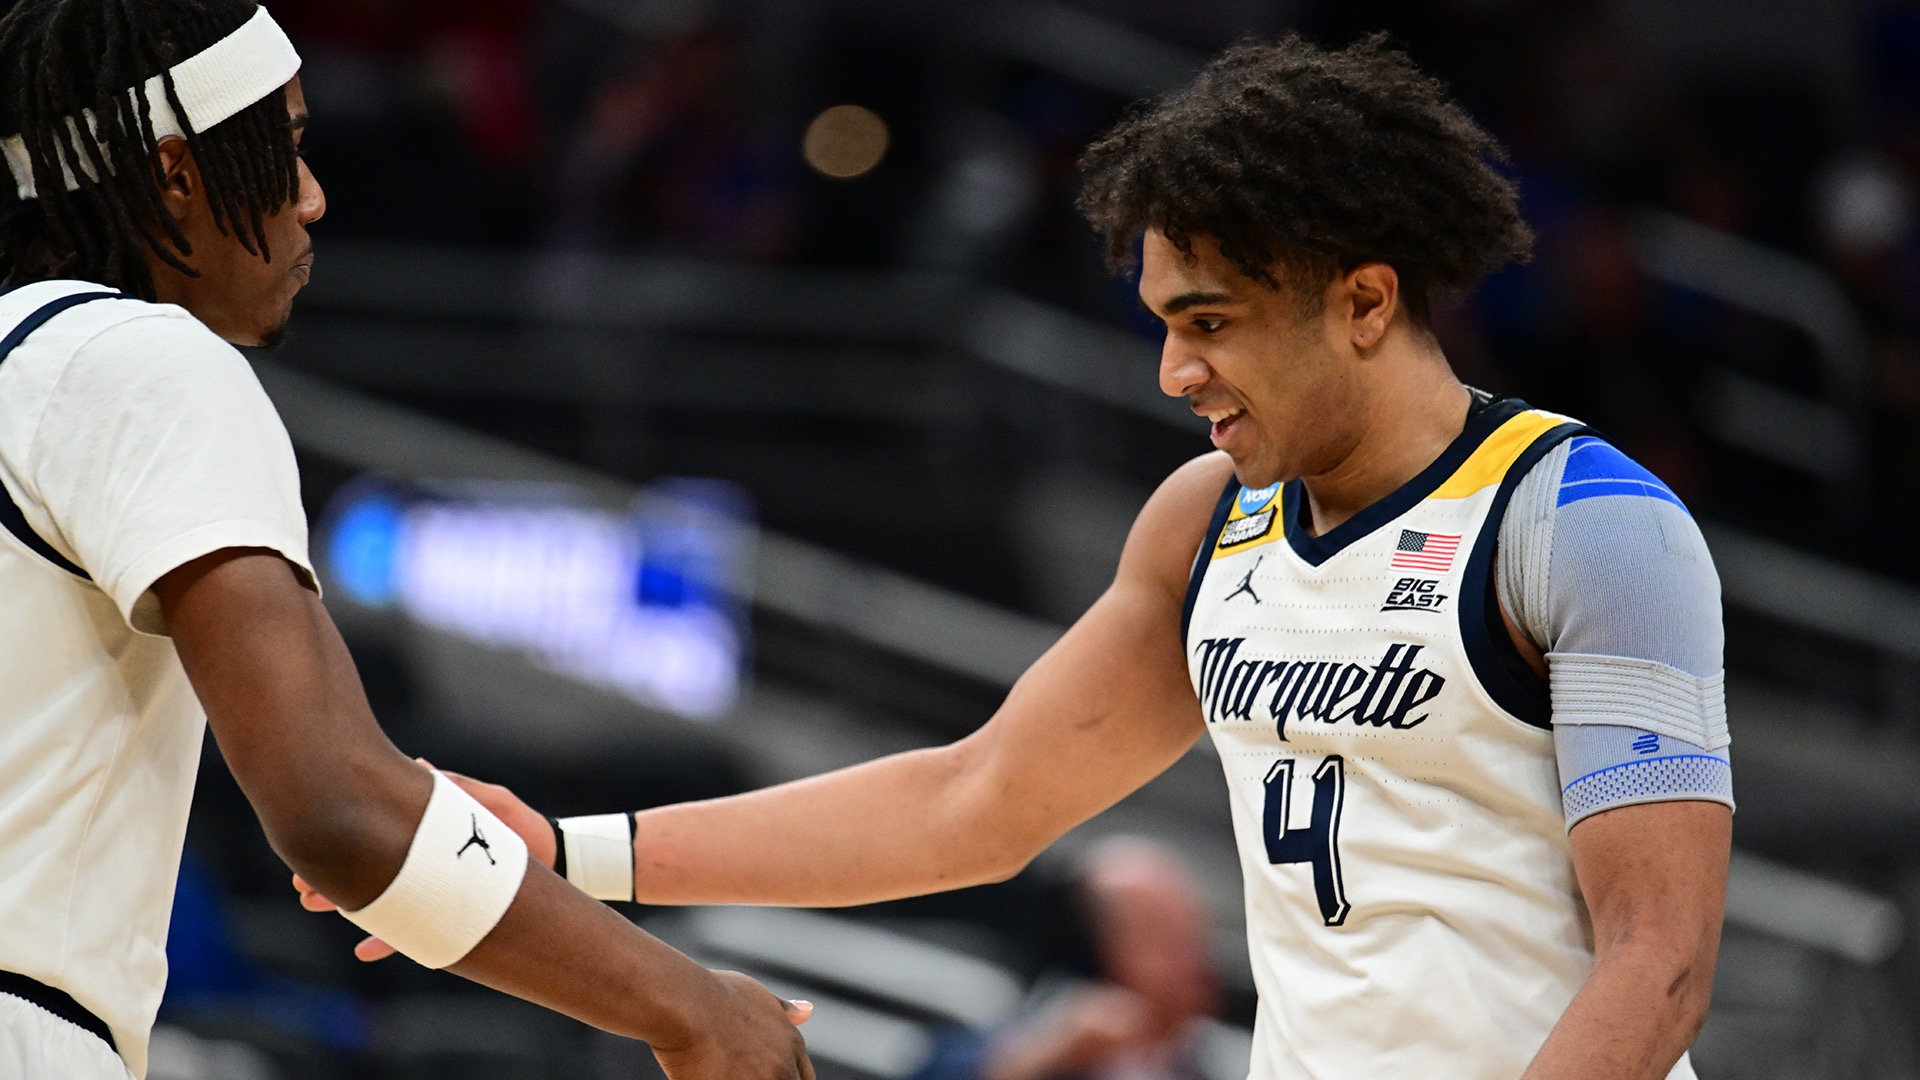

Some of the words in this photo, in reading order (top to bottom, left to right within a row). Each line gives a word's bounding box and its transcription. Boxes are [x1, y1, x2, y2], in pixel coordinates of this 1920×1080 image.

[1385, 592, 1448, 607] EAST
[1393, 578, 1439, 593] BIG
[1194, 638, 1446, 742] Marquette
[1263, 755, 1352, 926] 4
